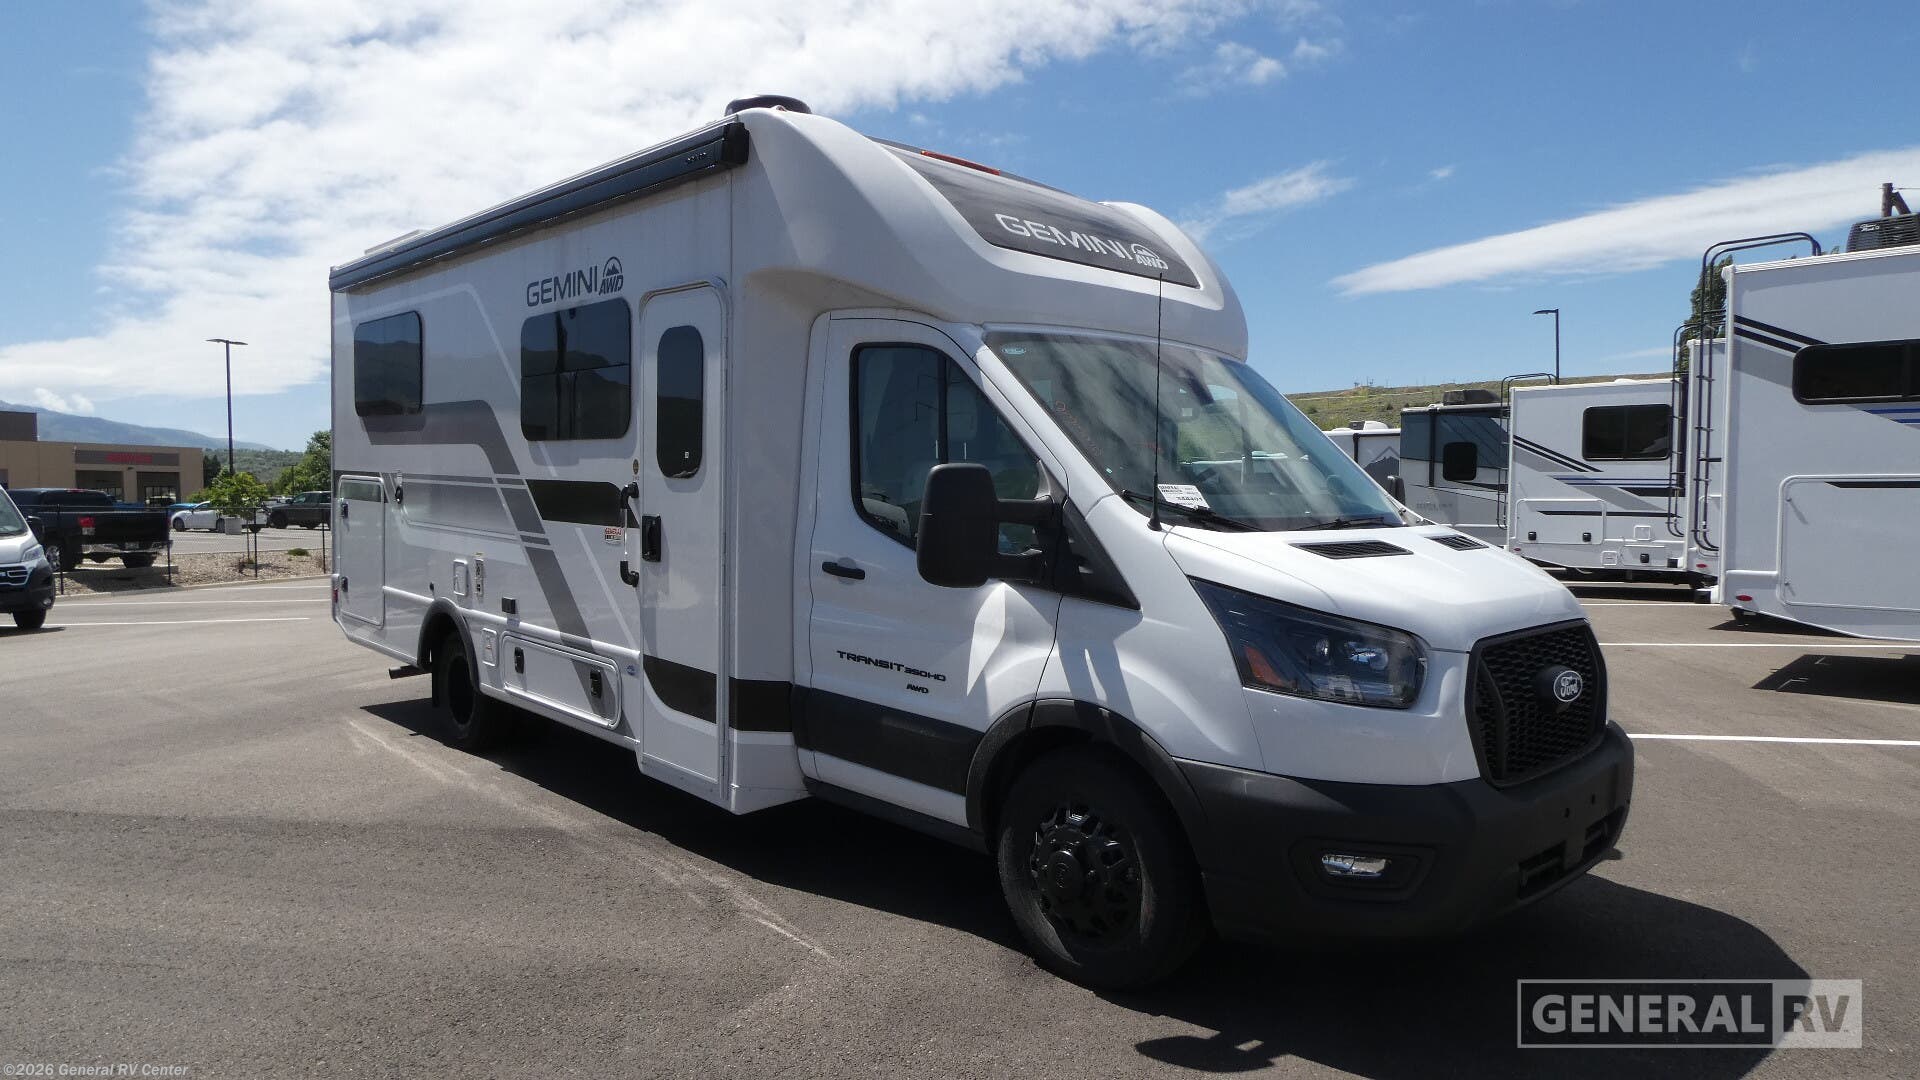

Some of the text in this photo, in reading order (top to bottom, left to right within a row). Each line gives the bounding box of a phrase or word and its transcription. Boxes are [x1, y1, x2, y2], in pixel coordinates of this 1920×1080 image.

[994, 213, 1133, 260] GEMINI
[1135, 254, 1169, 270] AWD
[526, 265, 598, 307] GEMINI
[598, 274, 624, 296] AWD
[836, 650, 905, 672] TRANSIT
[906, 683, 929, 694] AWD
[1560, 676, 1579, 698] Ford
